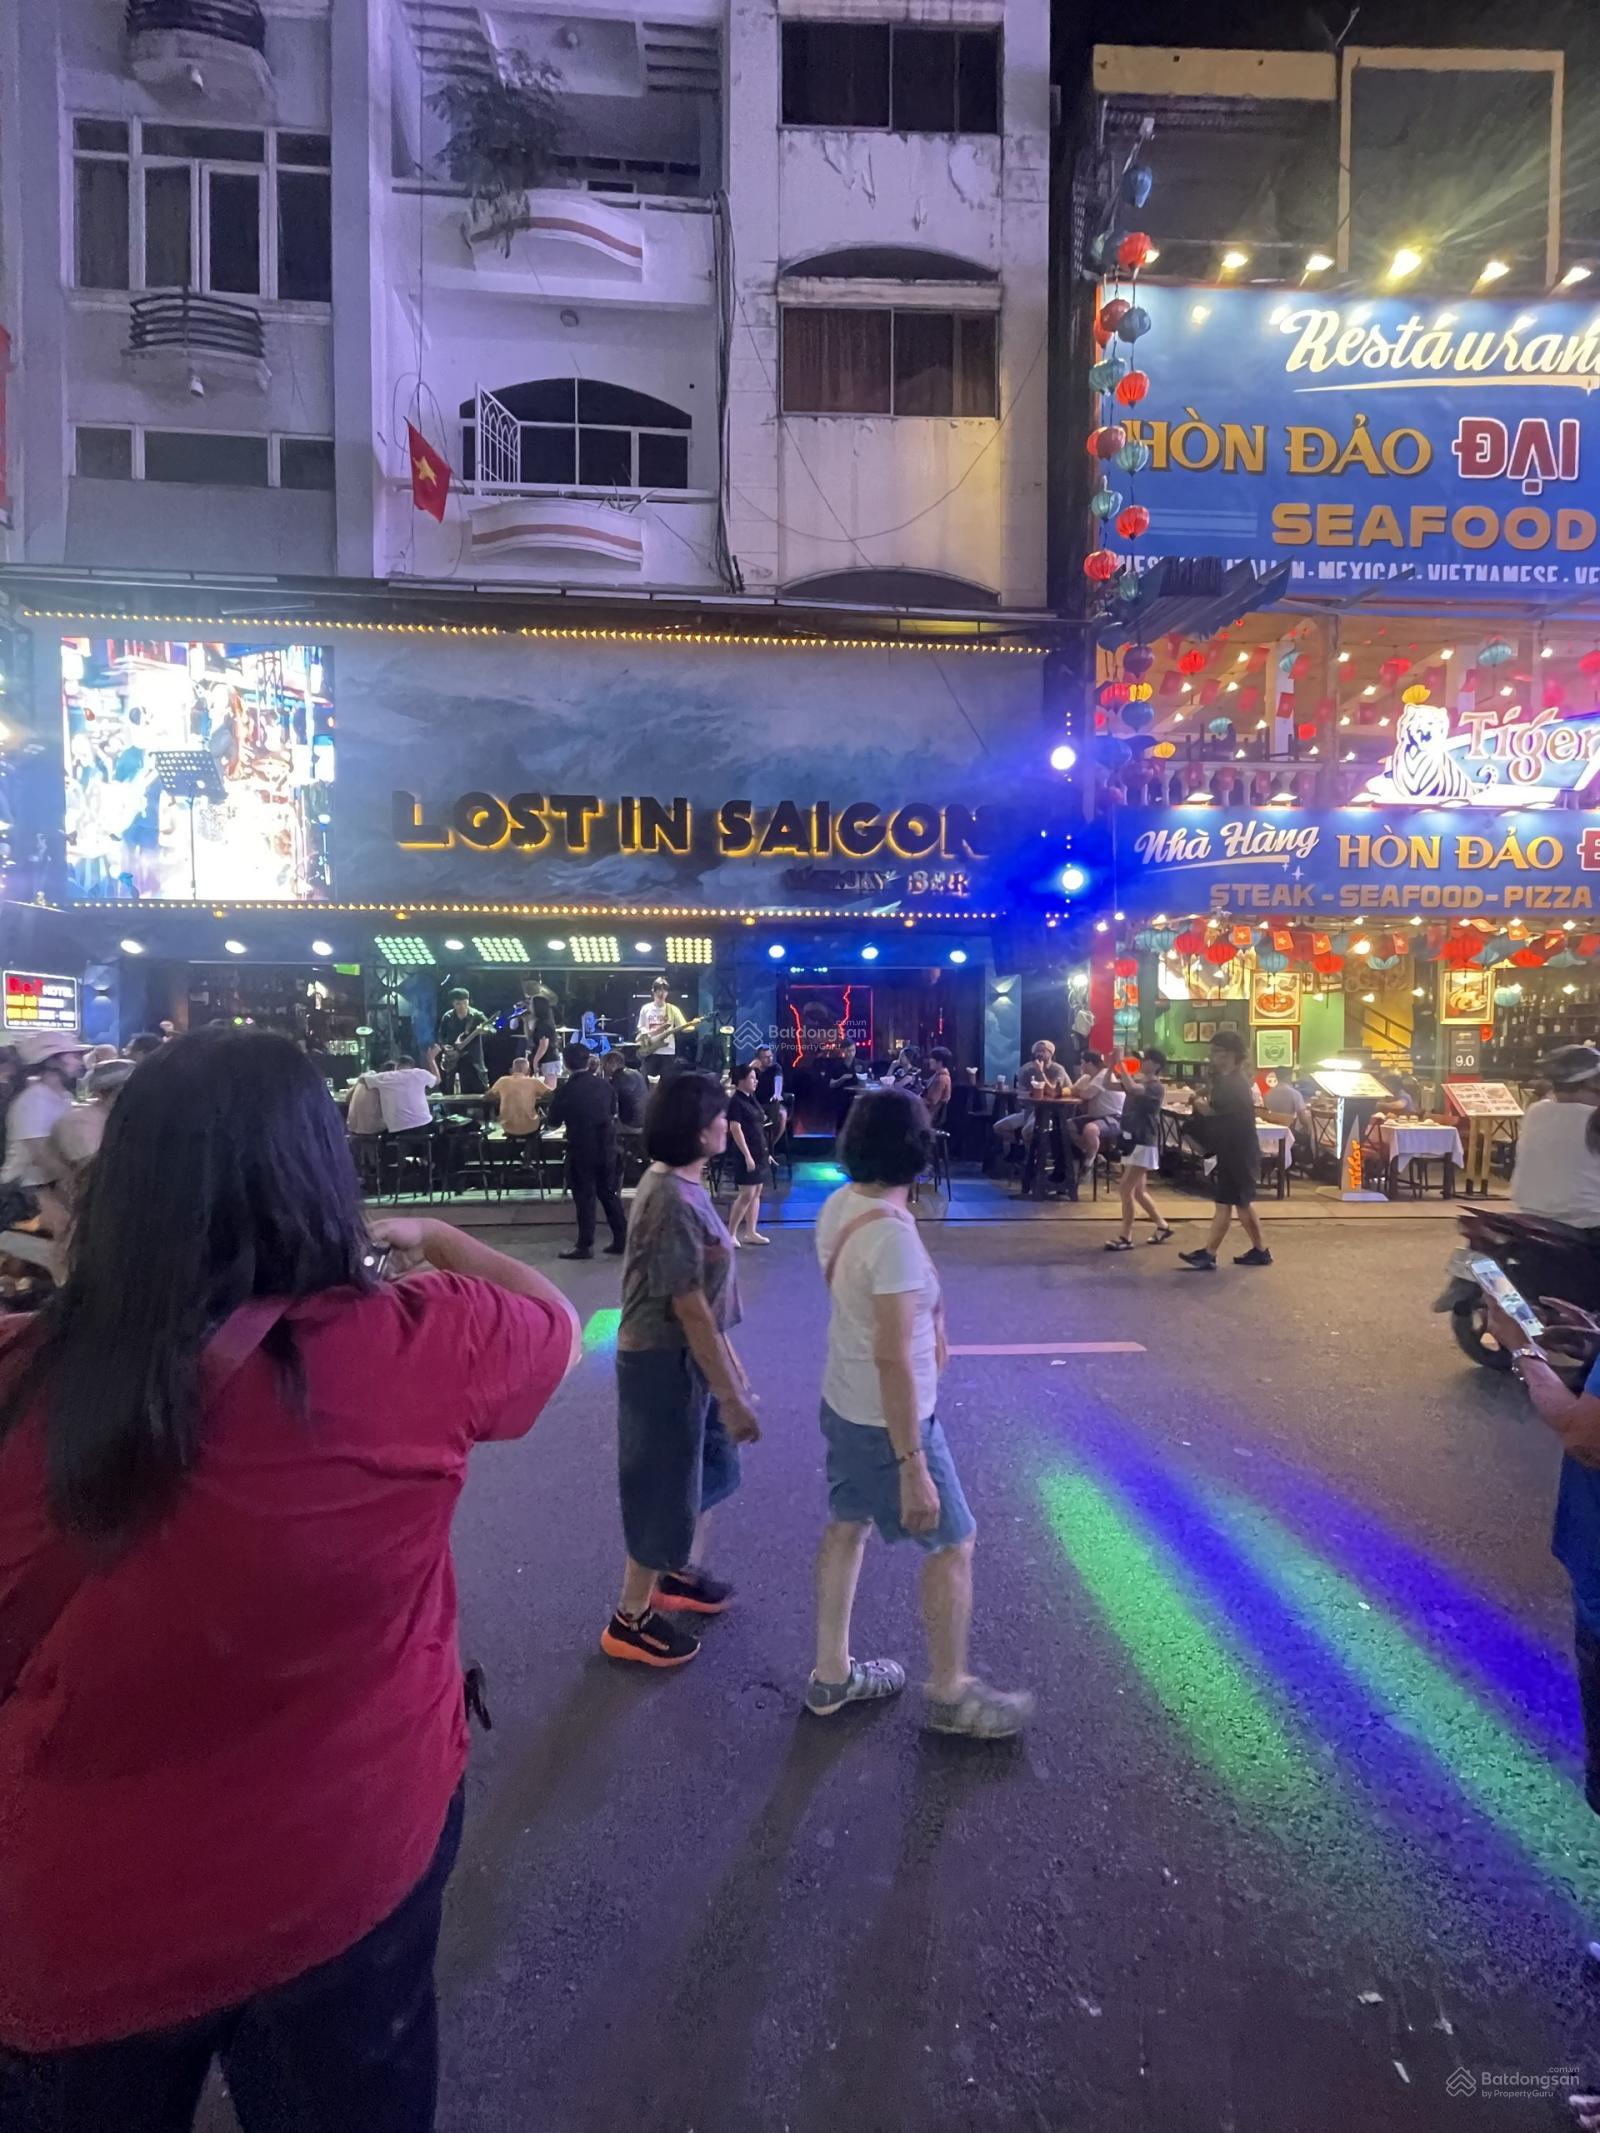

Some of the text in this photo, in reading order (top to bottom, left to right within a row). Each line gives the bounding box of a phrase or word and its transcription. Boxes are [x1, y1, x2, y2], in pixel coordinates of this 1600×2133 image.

[1279, 309, 1600, 374] Restauran
[1120, 407, 1580, 496] HÒN ĐẢO ĐẠI
[1271, 502, 1598, 551] SEAFOOD
[1427, 563, 1559, 583] VIETNAMESE
[392, 790, 995, 859] LOST IN SAIGON
[1134, 827, 1211, 864] Nhà
[1219, 820, 1320, 859] Hàng
[1336, 825, 1441, 869] HÒN
[1454, 825, 1564, 870] ĐẢO
[1209, 883, 1317, 907] STEAK
[1339, 884, 1486, 909] SEAFOOD
[1503, 886, 1593, 910] PIZZA
[1455, 1054, 1475, 1067] 9.0
